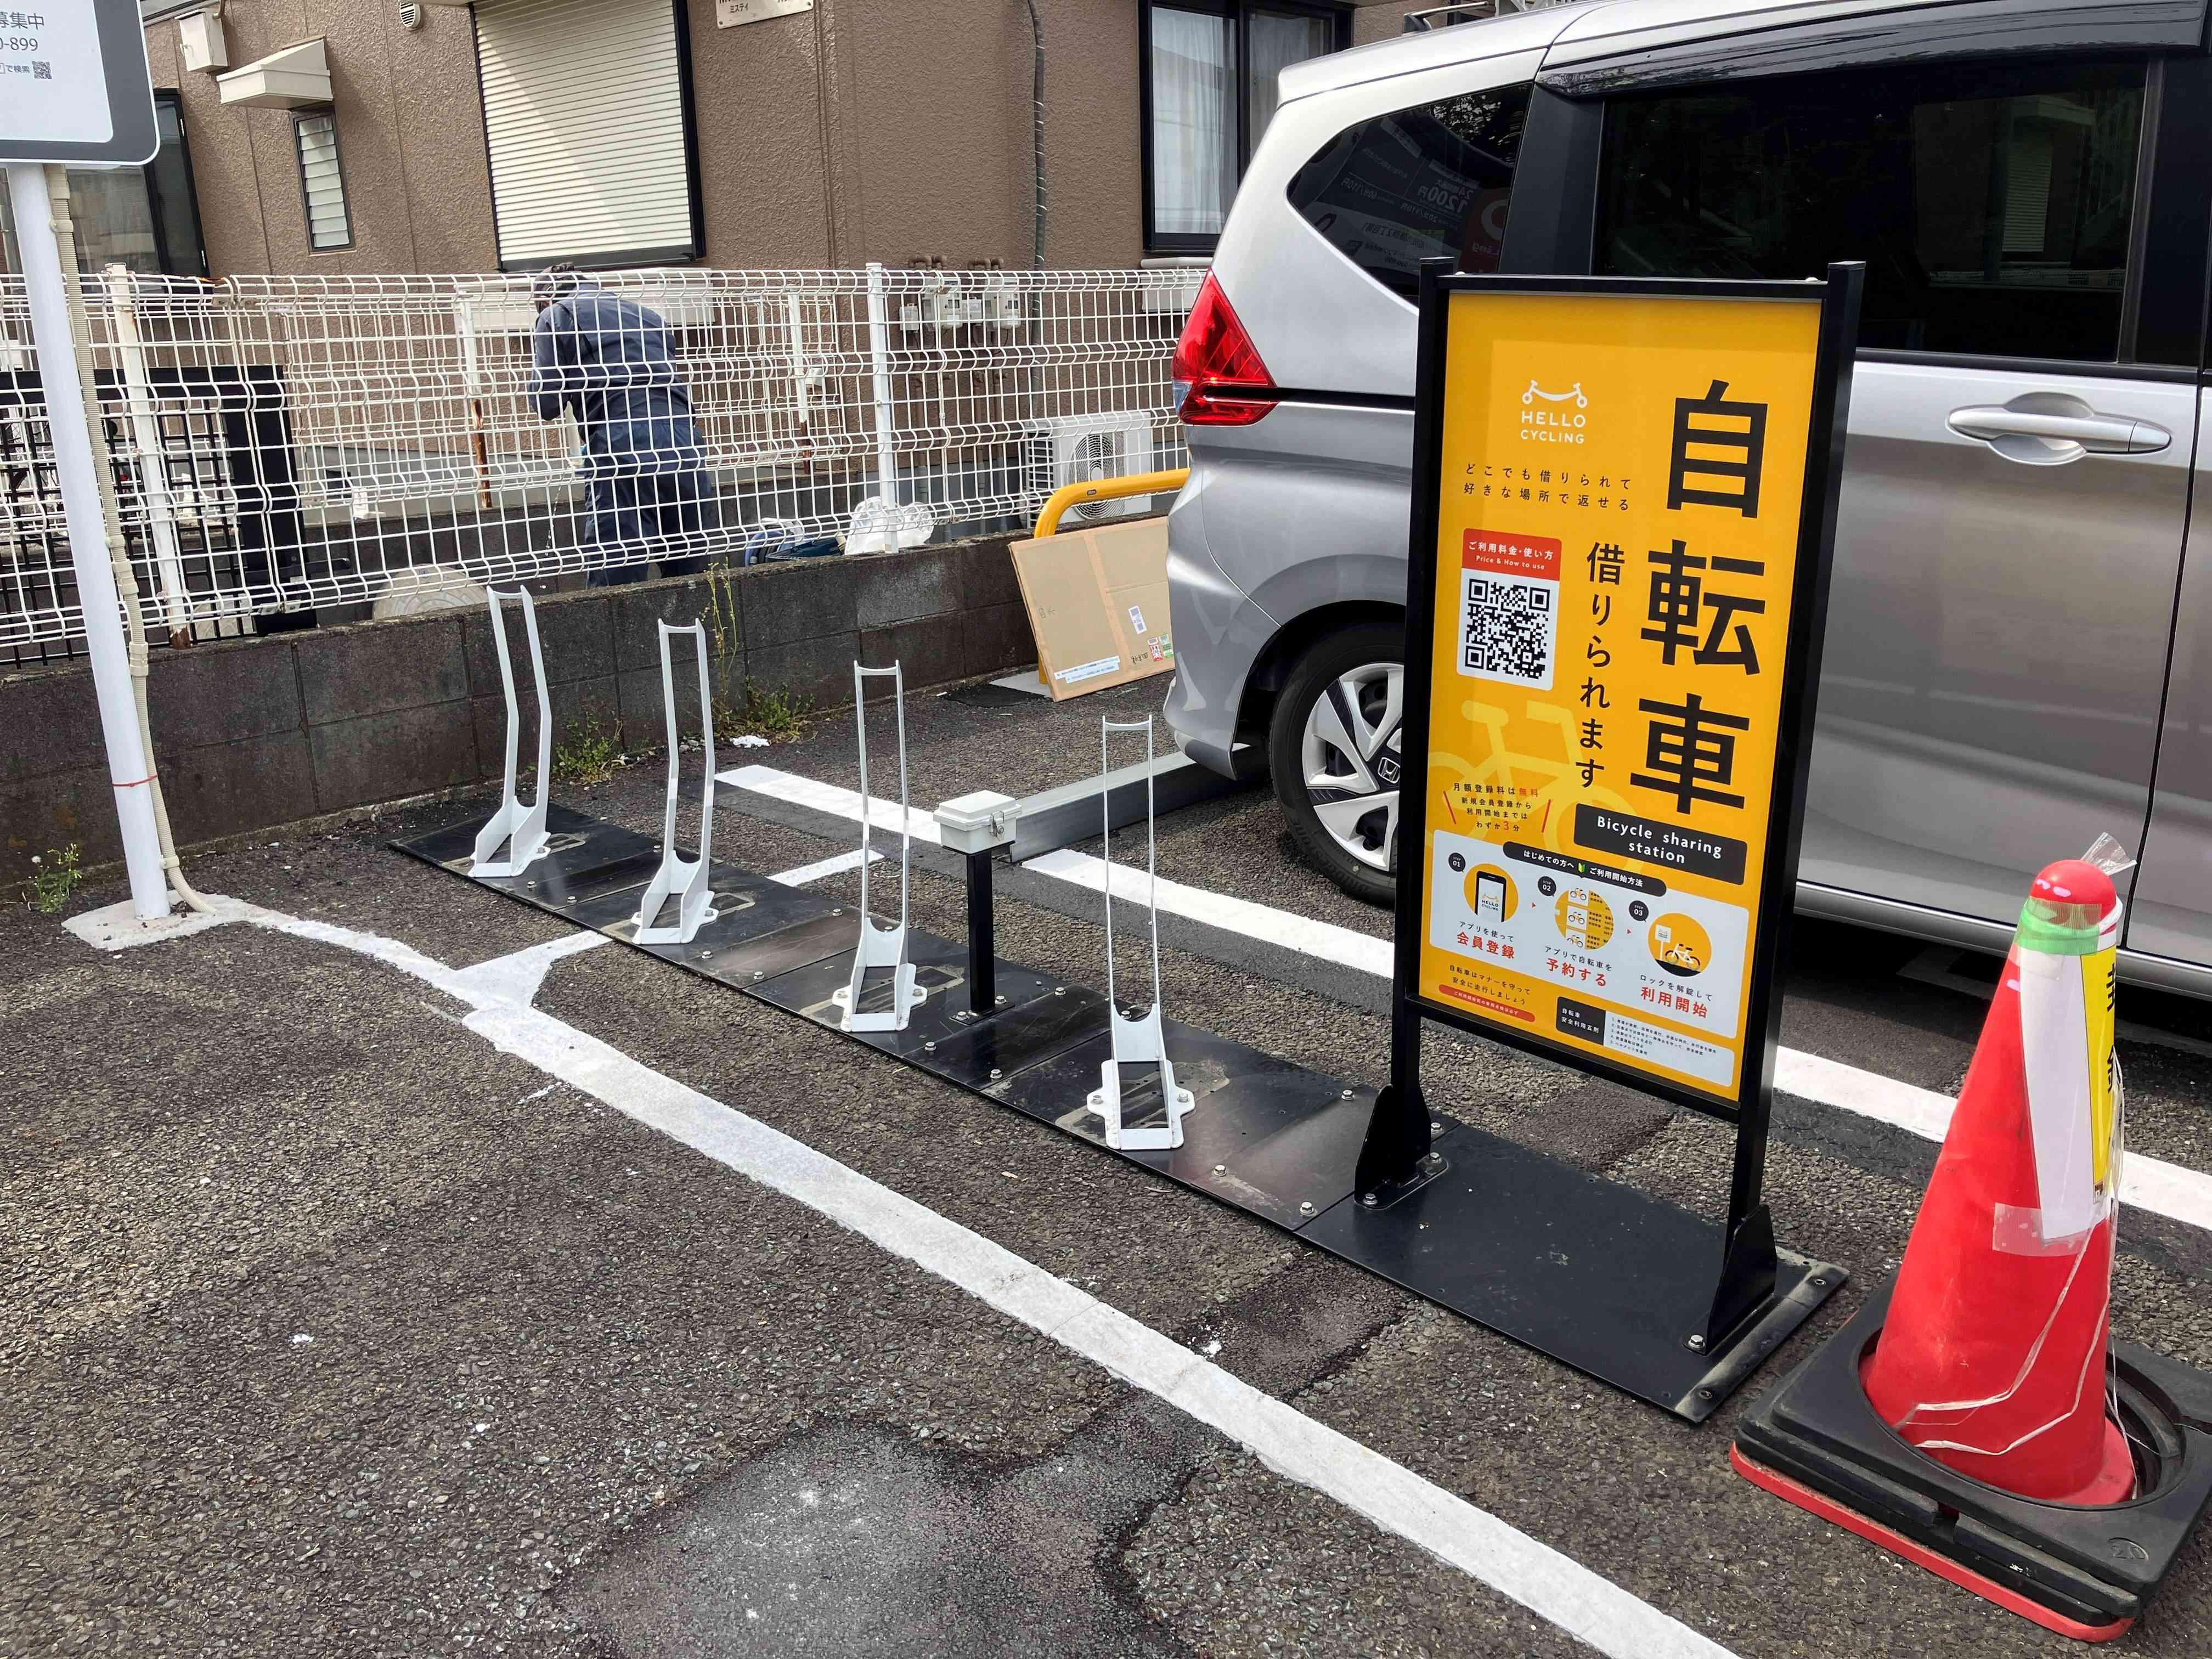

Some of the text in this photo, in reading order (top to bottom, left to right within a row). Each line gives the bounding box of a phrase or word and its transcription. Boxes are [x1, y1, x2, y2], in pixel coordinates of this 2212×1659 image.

[1521, 410, 1586, 428] HELLO
[1520, 429, 1585, 444] CYCLING
[1465, 463, 1630, 490] どこでも借りられて
[1463, 482, 1629, 511] 好きな場所で返せる
[1476, 555, 1494, 563] Price
[1504, 558, 1520, 567] How
[1629, 379, 1768, 814] 自転車
[1575, 541, 1626, 788] 借りられます
[1597, 816, 1722, 859] Bicycle sharing
[1629, 841, 1685, 864] station
[1523, 849, 1643, 888] はじめての方へ ご利用開始方法
[1481, 899, 1499, 907] HELLO
[1457, 932, 1515, 959] 会員登録
[1459, 921, 1514, 943] アプリを使って
[1544, 946, 1612, 972] アプリで自転車を
[1546, 958, 1606, 986] 予約する
[1561, 1007, 1581, 1019] 自転車
[1640, 986, 1708, 1018] 利用開始
